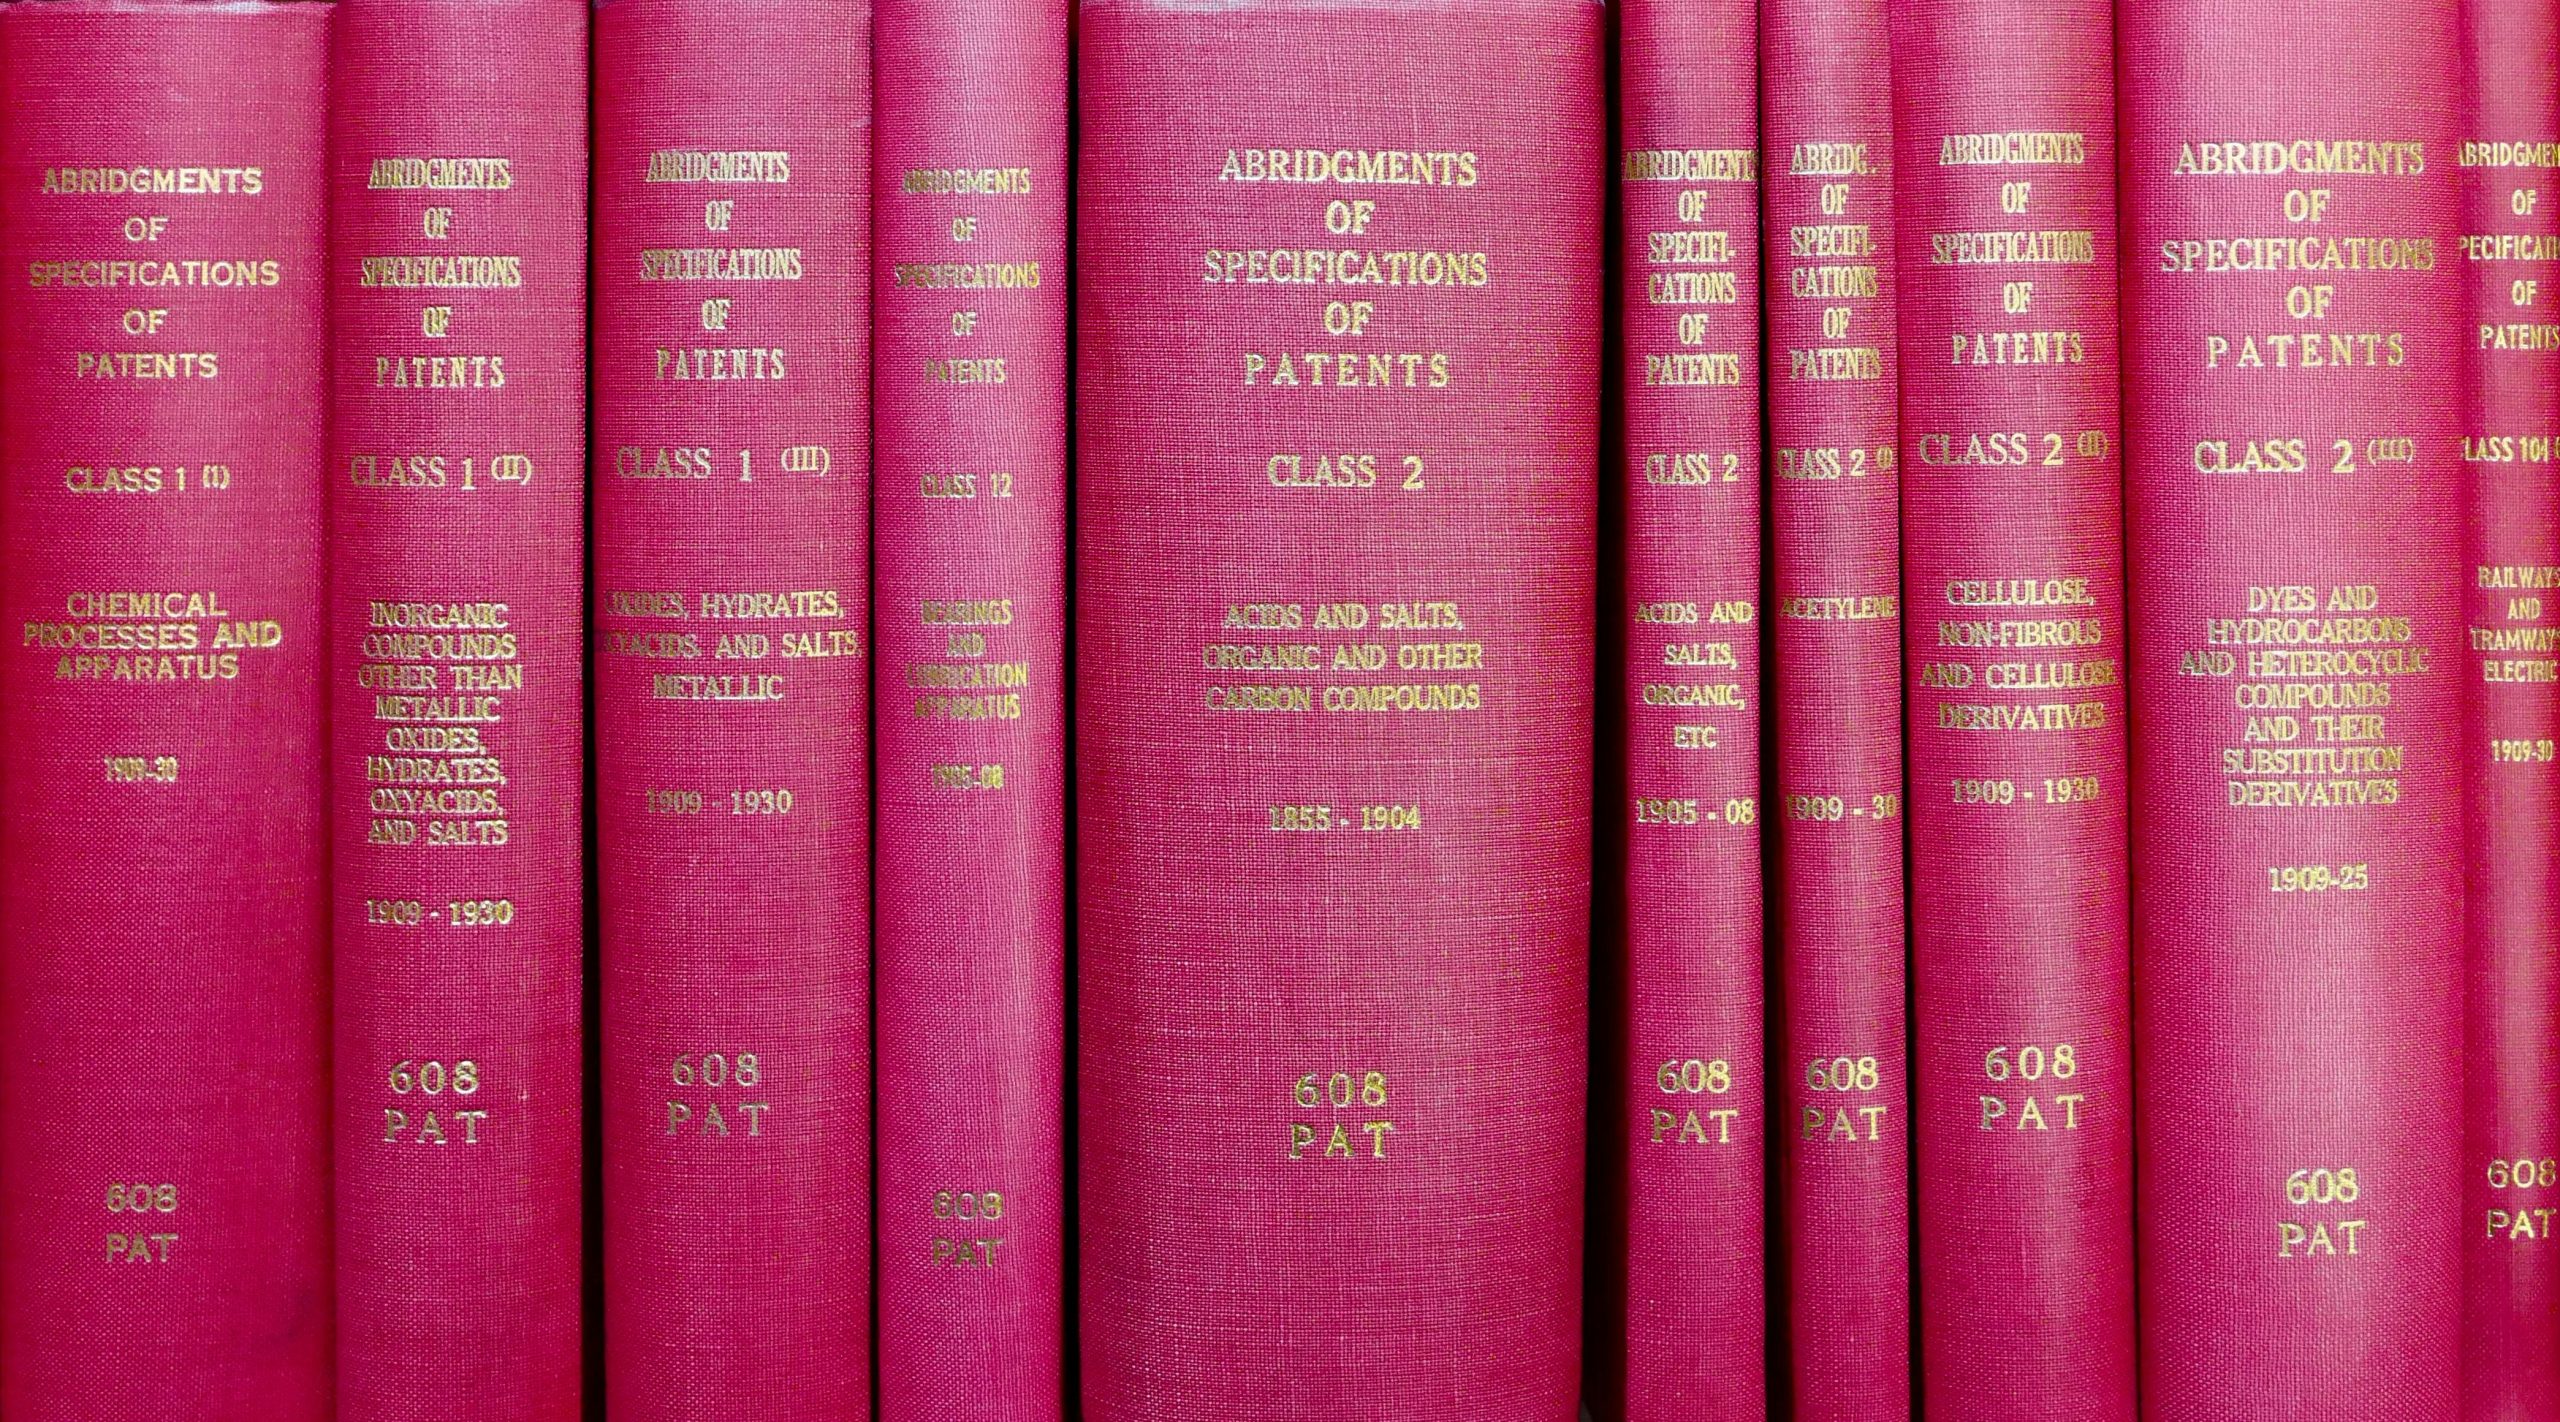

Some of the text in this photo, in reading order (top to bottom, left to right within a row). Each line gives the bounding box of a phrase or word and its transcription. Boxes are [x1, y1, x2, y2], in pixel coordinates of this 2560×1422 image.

[1791, 142, 1877, 176] ABRIDG.
[1941, 131, 2084, 164] ABRIDGMENTS
[2176, 140, 2423, 174] ABRIDGMENTS
[45, 166, 263, 194] ABRIDGMENTS
[371, 158, 512, 189] ABRIDGMENTS
[648, 151, 790, 182] ABRIDGMENTS
[1220, 150, 1477, 186] ABRIDGMENTS
[1678, 190, 1708, 222] OF
[1821, 183, 1849, 215] OF
[2001, 182, 2030, 213] OF
[2284, 189, 2331, 222] OF
[2512, 189, 2536, 215] OF
[124, 216, 168, 242] OF
[424, 208, 452, 239] OF
[705, 200, 733, 231] OF
[952, 216, 976, 242] OF
[1325, 200, 1375, 234] OF
[1934, 230, 2093, 263] SPECIFICATIONS
[2163, 237, 2434, 271] SPECIFICATIONS
[31, 260, 280, 286] SPECIFICATIONS
[362, 256, 521, 287] SPECIFICATIONS
[643, 248, 802, 280] SPECIFICATIONS
[1205, 250, 1488, 286] SPECIFICATIONS
[1649, 272, 1737, 303] CATIONS
[1792, 265, 1878, 298] CATIONS
[2511, 280, 2536, 305] OF
[2003, 282, 2032, 313] OF
[2286, 285, 2333, 318] OF
[123, 309, 168, 334] OF
[423, 306, 452, 337] OF
[701, 298, 731, 330] OF
[952, 310, 976, 336] OF
[1324, 301, 1373, 335] OF
[1678, 313, 1708, 345] OF
[1823, 307, 1851, 338] OF
[1954, 330, 2083, 364] PATENTS
[2208, 333, 2403, 367] PATENTS
[2481, 324, 2560, 350] PATENTS
[79, 352, 218, 378] PATENTS
[378, 356, 505, 388] PATENTS
[657, 348, 786, 380] PATENTS
[927, 358, 1007, 384] PATENTS
[1246, 353, 1450, 387] PATENTS
[1648, 353, 1740, 385] PATENTS
[1792, 346, 1881, 380] PATENTS
[617, 446, 830, 482] CLASS 1 (III)
[1778, 447, 1865, 480] CLASS 2
[1920, 431, 2063, 467] CLASS 2
[2195, 437, 2415, 473] CLASS 2 (III)
[66, 466, 164, 493] CLASS
[176, 467, 185, 491] 1
[352, 454, 533, 490] CLASS 1 (II)
[1268, 454, 1424, 490] CLASS 2
[1647, 453, 1738, 485] CLASS 2
[921, 472, 1012, 499] CLASS 12
[68, 592, 227, 618] CHEMICAL
[702, 590, 844, 618] HYDRATES,
[1947, 577, 2095, 607] CELLULOSE,
[2249, 585, 2377, 612] DYES AND
[372, 602, 508, 629] INORGANIC
[1224, 601, 1463, 629] ACIDS AND SALTS,
[1636, 600, 1753, 627] ACIDS AND
[1783, 596, 1895, 620] ACETYLENE
[2508, 597, 2541, 620] AND
[25, 619, 282, 650] PROCESSES AND
[367, 633, 517, 659] COMPOUNDS
[716, 634, 770, 659] AND
[1940, 620, 2101, 648] NON-FIBROUS
[2210, 618, 2410, 644] HYDROCARBONS
[57, 652, 239, 680] APPARATUS
[1203, 642, 1482, 671] ORGANIC AND OTHER
[1665, 642, 1738, 669] SALTS,
[2180, 644, 2426, 677] AND HETEROCYCLIC
[2485, 658, 2556, 682] ELECTRIC
[359, 663, 522, 690] OTHER THAN
[654, 674, 784, 701] METALLIC
[1921, 661, 2114, 690] AND CELLULOSE
[377, 696, 501, 722] METALLIC
[1206, 684, 1481, 711] CARBON COMPOUNDS
[1644, 682, 1746, 710] ORGANIC,
[2236, 682, 2390, 709] COMPOUNDS
[1940, 701, 2105, 731] DERIVATIVES
[2245, 714, 2383, 741] AND THEIR
[387, 726, 486, 757] OXIDES,
[1675, 725, 1718, 748] ETC
[2492, 739, 2553, 762] 1909-30
[368, 757, 507, 788] HYDRATES,
[2224, 746, 2402, 774] SUBSTITUTION
[371, 788, 504, 819] OXYACIDS,
[647, 789, 794, 814] 1909 1930
[1954, 777, 2098, 806] 1909 1930
[2230, 778, 2399, 806] DERIVATIVES
[1270, 805, 1421, 831] 1855 1904
[1637, 798, 1754, 825] 1905 08
[1787, 794, 1897, 821] 1909 30
[369, 818, 509, 845] AND SALTS
[2270, 863, 2368, 891] 1909-25
[367, 899, 514, 926] 1909 1930
[390, 1060, 479, 1095] 608
[672, 1052, 760, 1087] 608
[1658, 1058, 1732, 1094] 608
[1808, 1055, 1879, 1092] 608
[1986, 1043, 2077, 1081] 608
[1295, 1071, 1387, 1107] 608
[384, 1109, 487, 1144] PAT
[667, 1100, 769, 1135] PAT
[1652, 1108, 1739, 1144] PAT
[1803, 1105, 1887, 1141] PAT
[1981, 1093, 2084, 1131] PAT
[1290, 1120, 1394, 1159] PAT
[2286, 1168, 2359, 1204] 608
[2487, 1156, 2556, 1189] 608
[107, 1182, 177, 1213] 608
[934, 1191, 1004, 1220] 608
[2279, 1220, 2366, 1257] PAT
[2487, 1209, 2554, 1239] PAT
[107, 1233, 178, 1262] PAT
[933, 1238, 1004, 1267] PAT
